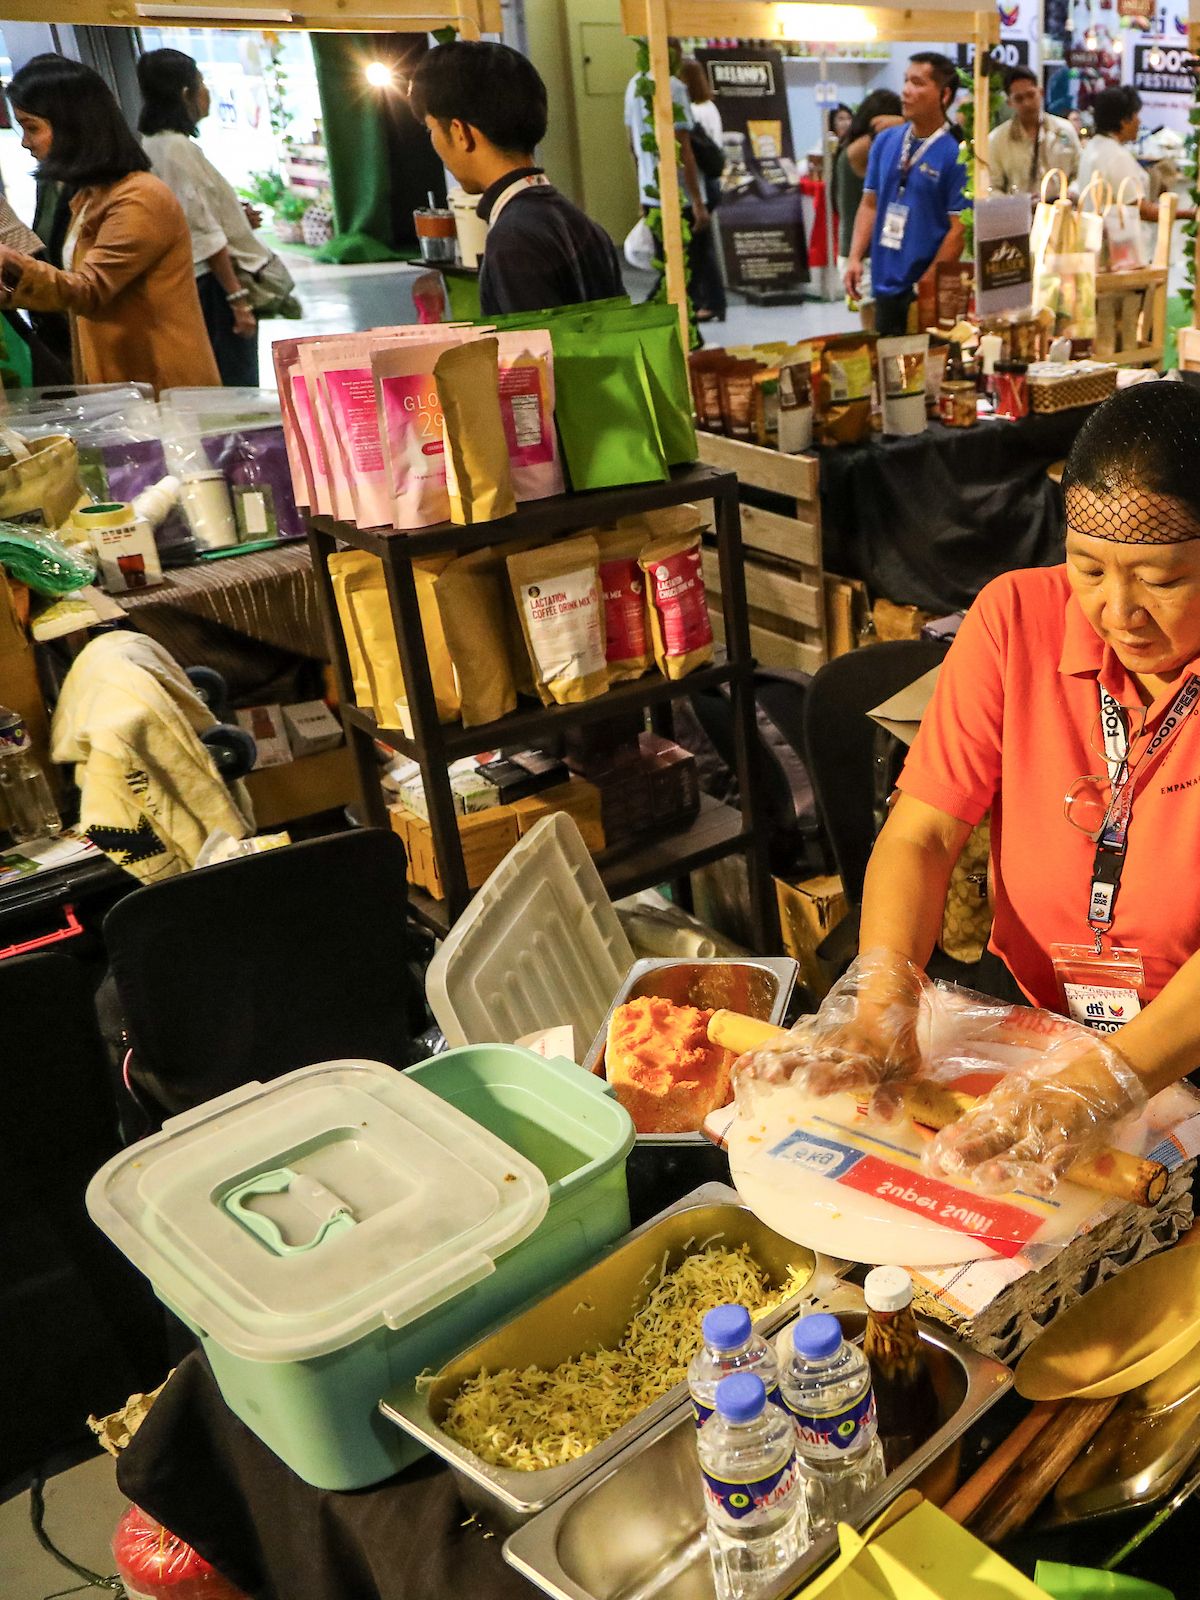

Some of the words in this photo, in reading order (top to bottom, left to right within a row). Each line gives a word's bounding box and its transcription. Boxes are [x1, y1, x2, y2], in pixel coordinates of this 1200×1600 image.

[966, 44, 1020, 67] FOD
[1136, 73, 1197, 90] FESTIVA
[403, 392, 440, 412] GLO
[530, 591, 567, 610] LACTATION
[532, 605, 558, 620] COFFEE
[558, 600, 579, 613] DRINK
[578, 597, 592, 608] MIX
[1104, 694, 1121, 738] FOOD
[1147, 715, 1177, 756] FOOD
[1086, 1001, 1106, 1016] dti
